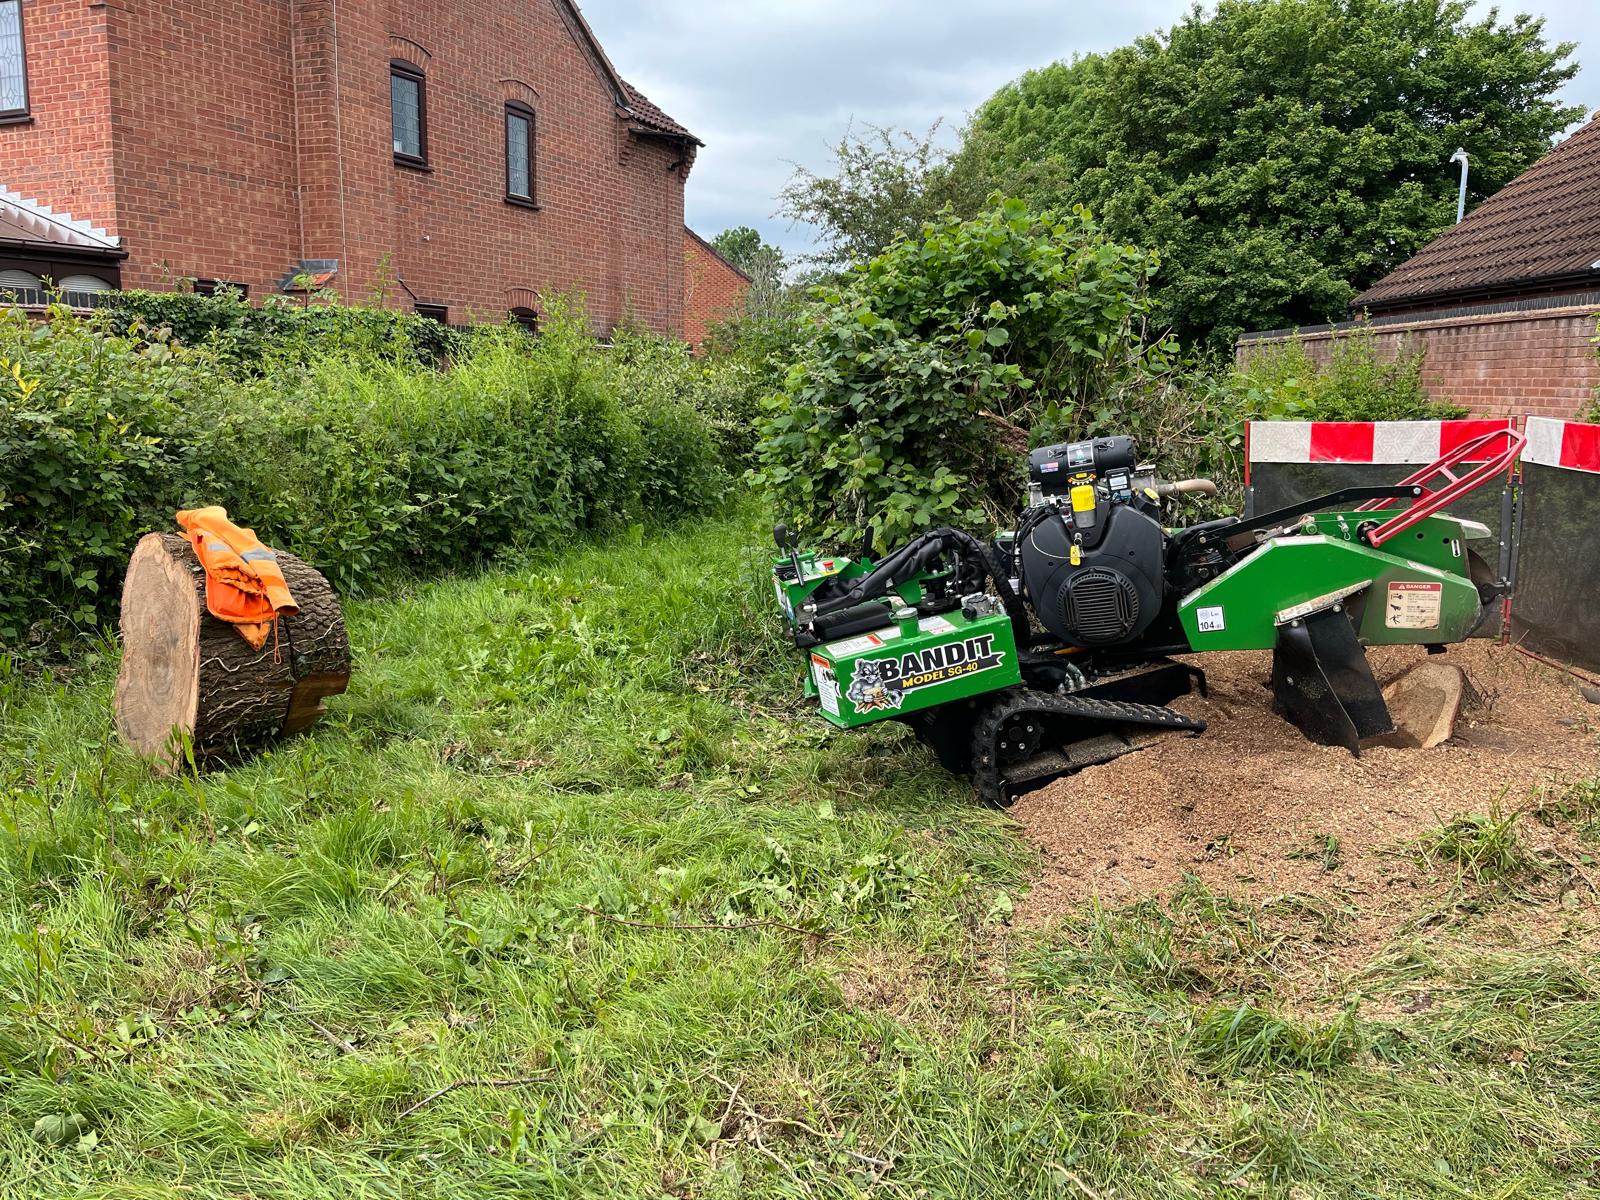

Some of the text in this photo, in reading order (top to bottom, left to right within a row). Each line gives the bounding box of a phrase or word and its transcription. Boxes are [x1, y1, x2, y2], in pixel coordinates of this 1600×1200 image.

[1200, 621, 1214, 630] 104
[879, 635, 993, 680] BANDIT
[902, 661, 978, 688] MODEL SG-40
